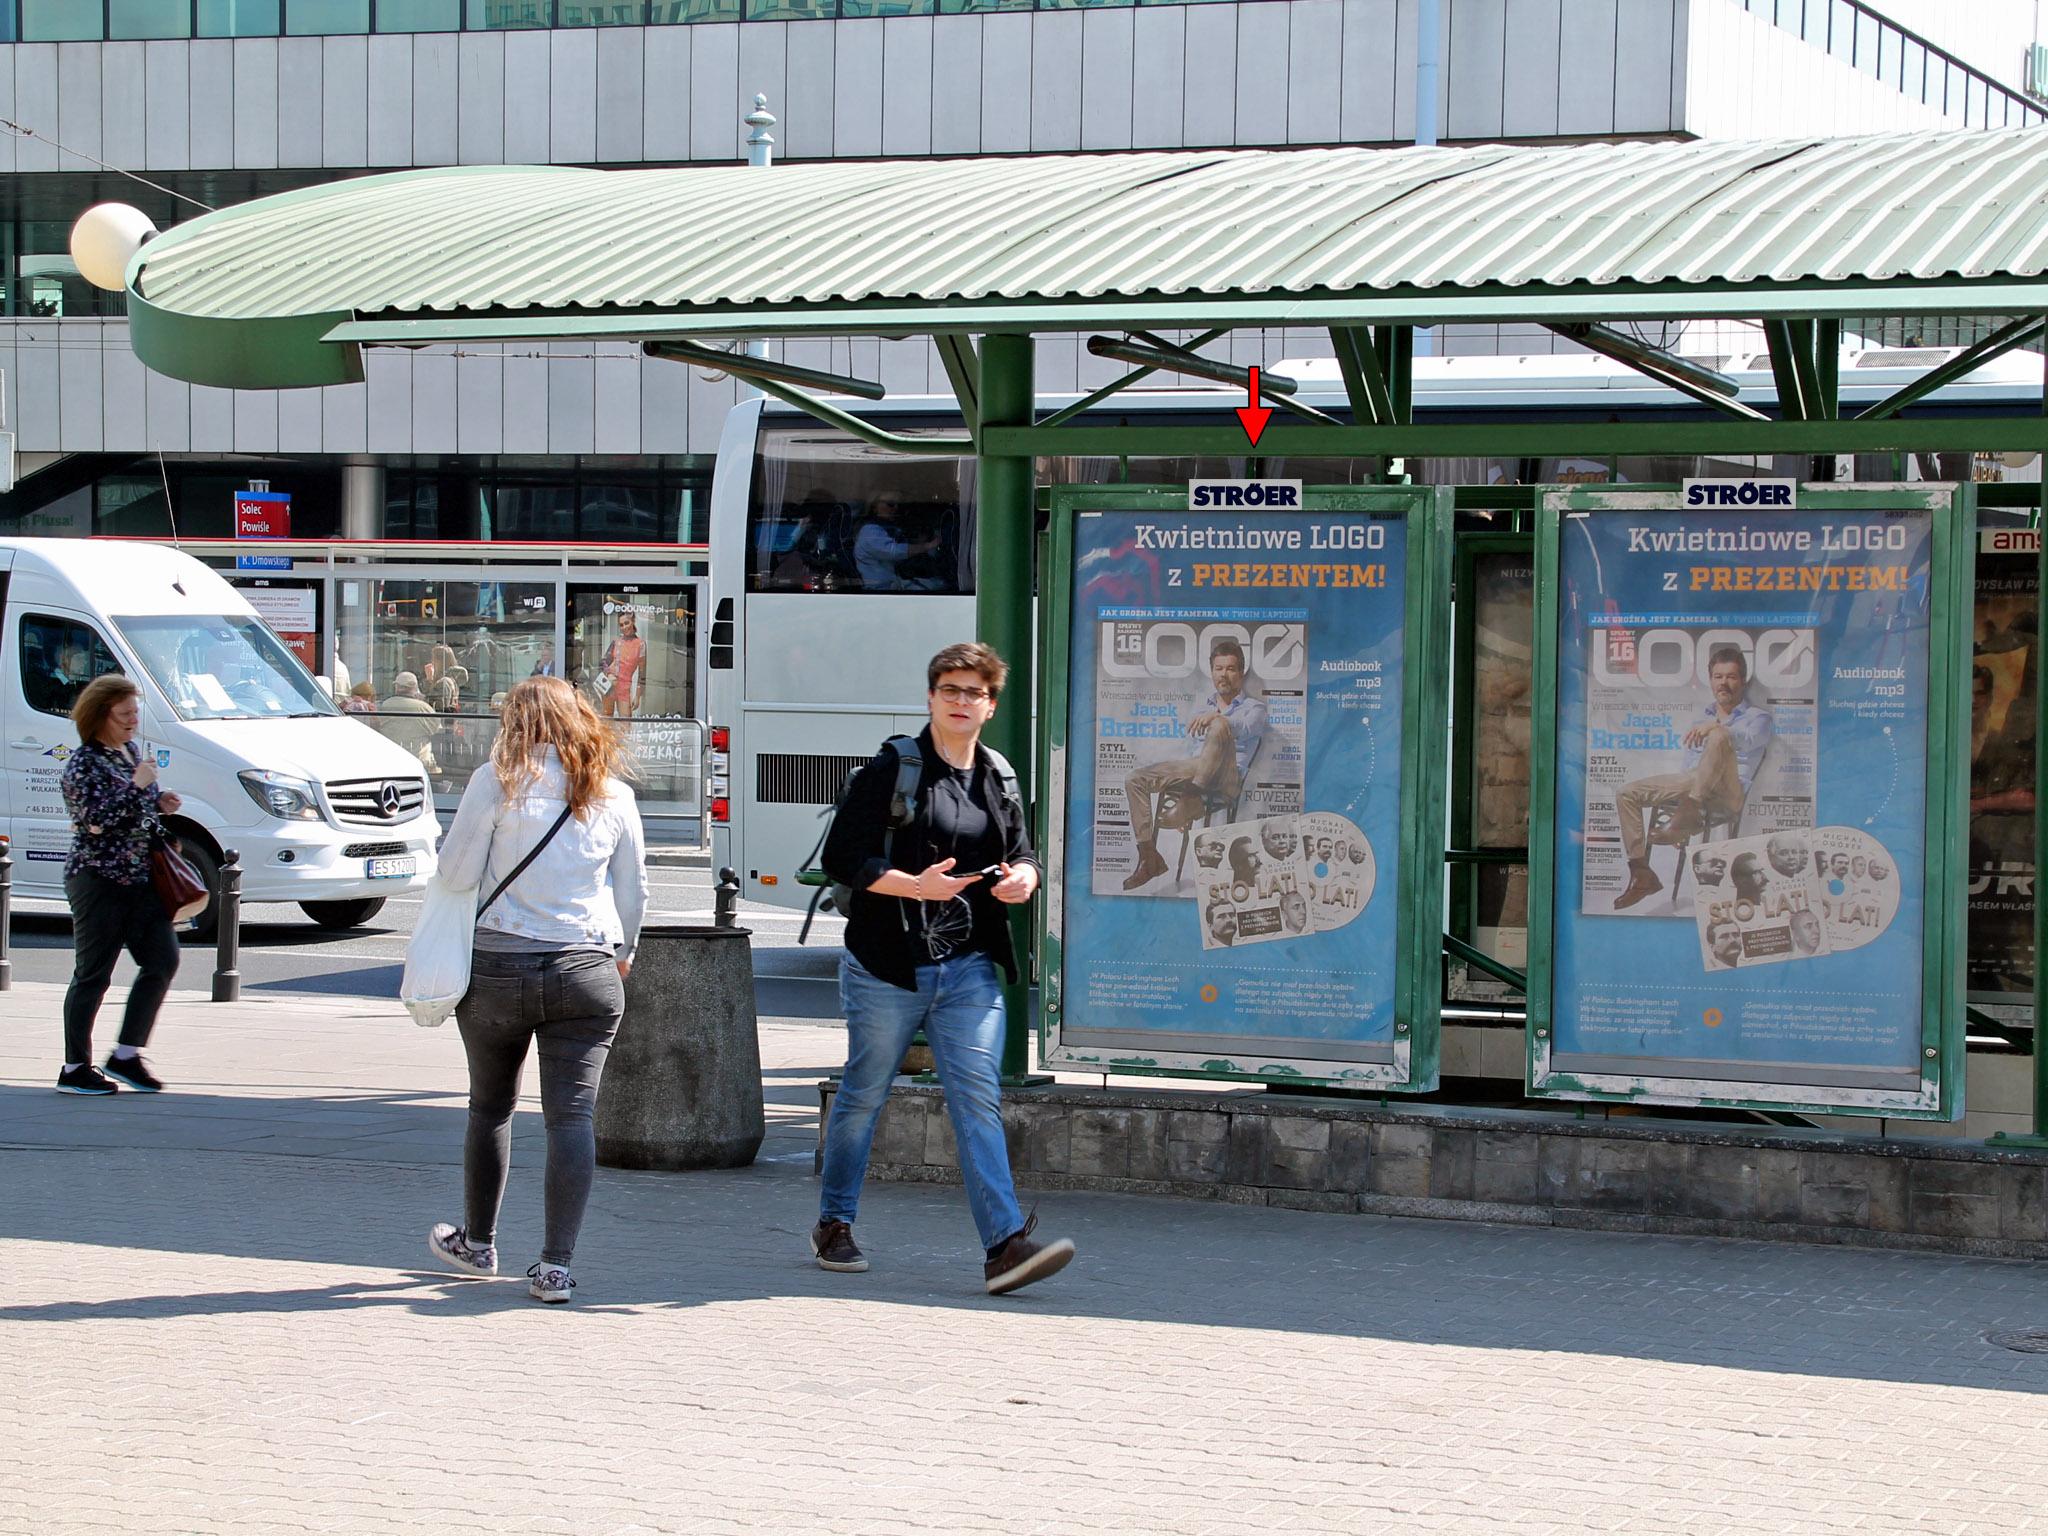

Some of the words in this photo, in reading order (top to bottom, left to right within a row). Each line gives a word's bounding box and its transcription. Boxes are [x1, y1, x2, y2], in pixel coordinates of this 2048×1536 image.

[1193, 483, 1298, 506] STRÖER
[1687, 482, 1791, 506] STRÖER
[241, 503, 262, 515] Solec
[241, 521, 270, 532] Powiśle
[1134, 525, 1301, 549] Kwietniowe
[1310, 525, 1385, 549] LOGO
[1628, 527, 1811, 552] Kwietniowe
[1821, 526, 1906, 551] LOGO
[252, 556, 289, 568] Dmowskiego
[1192, 564, 1386, 588] PREZENTEM!
[1689, 566, 1909, 591] PREZENTEM!
[1117, 635, 1141, 652] 16
[1101, 622, 1304, 680] LOGO
[1610, 642, 1634, 660] 16
[1593, 629, 1814, 688] LOGO
[1320, 660, 1382, 672] Audiobook
[1833, 667, 1905, 679] Audiobook
[1356, 677, 1382, 689] mp3
[1874, 685, 1905, 697] mp3
[1129, 703, 1178, 717] Jacek
[1858, 701, 1878, 709] gdzie
[1880, 701, 1905, 709] chcesz
[1622, 712, 1672, 727] Jacek
[1880, 711, 1905, 719] chcesz
[1100, 717, 1185, 738] Braciak
[1591, 729, 1681, 750] Braciak
[1100, 743, 1126, 752] STYL
[1590, 756, 1617, 765] STYL
[31, 767, 65, 776] TRANSPOR
[1245, 790, 1299, 803] ROWERY
[1269, 804, 1299, 813] WIELKI
[1748, 803, 1811, 817] ROWERY
[375, 861, 388, 875] ES
[1209, 879, 1250, 903] STO
[1257, 872, 1298, 900] LAT!
[1322, 884, 1359, 909] LAT!
[1709, 898, 1755, 925] STO
[1763, 888, 1809, 919] LAT!
[1838, 902, 1880, 928] LAT!
